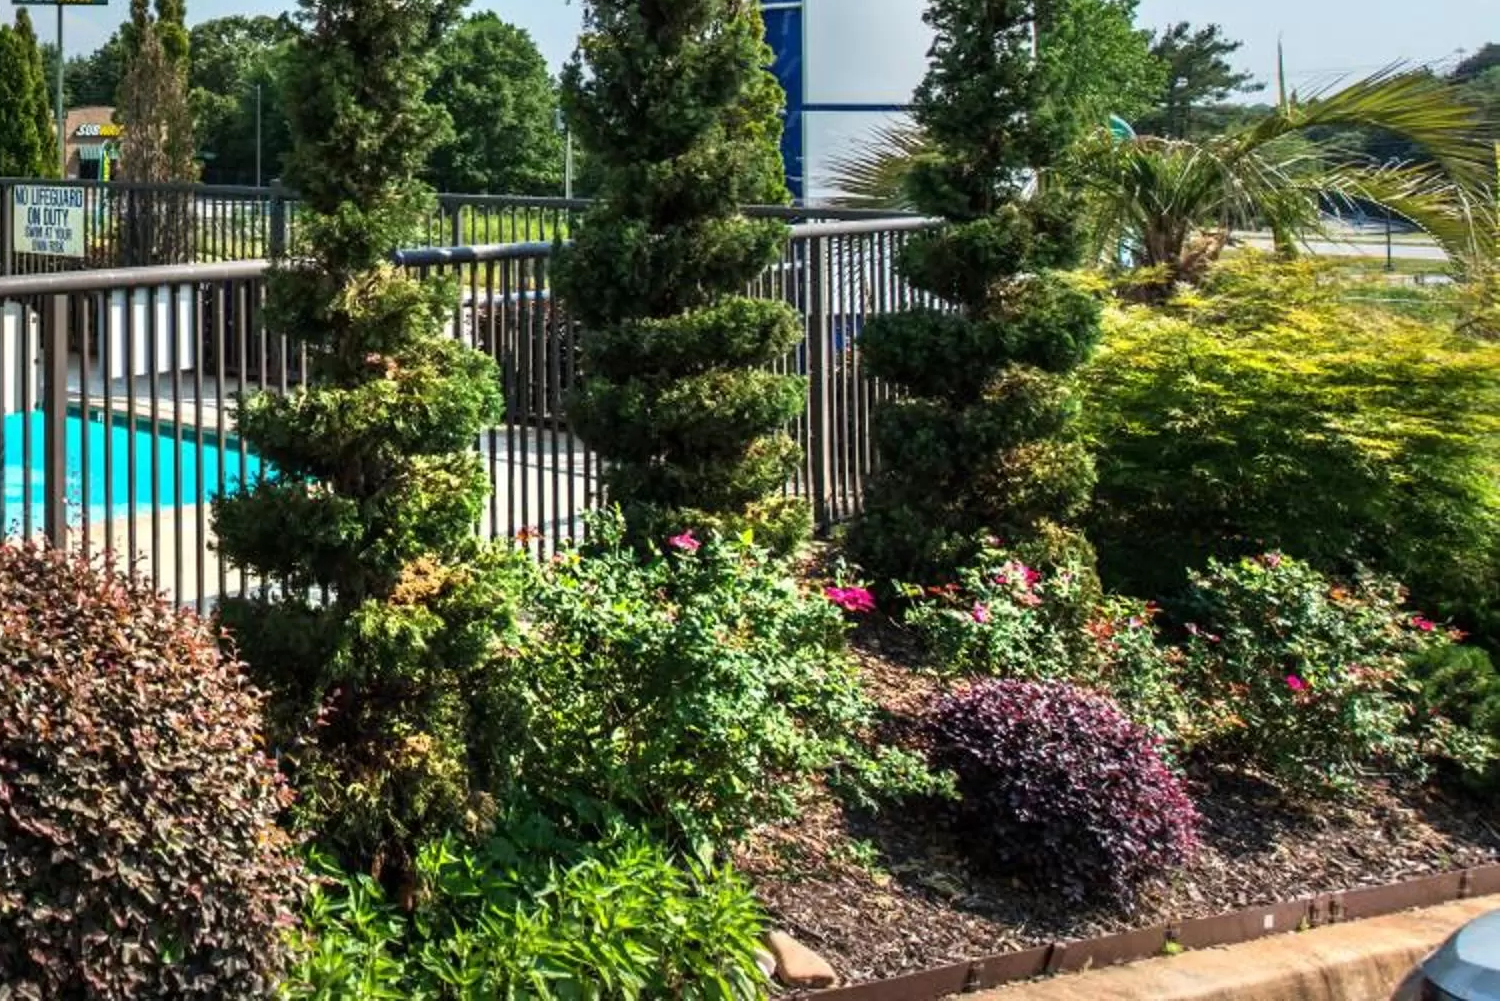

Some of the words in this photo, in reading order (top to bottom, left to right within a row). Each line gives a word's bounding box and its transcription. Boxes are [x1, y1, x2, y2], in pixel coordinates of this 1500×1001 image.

[16, 187, 28, 205] NO
[32, 188, 82, 207] LIFEGUARD
[28, 207, 40, 225] ON
[44, 208, 68, 227] DUTY
